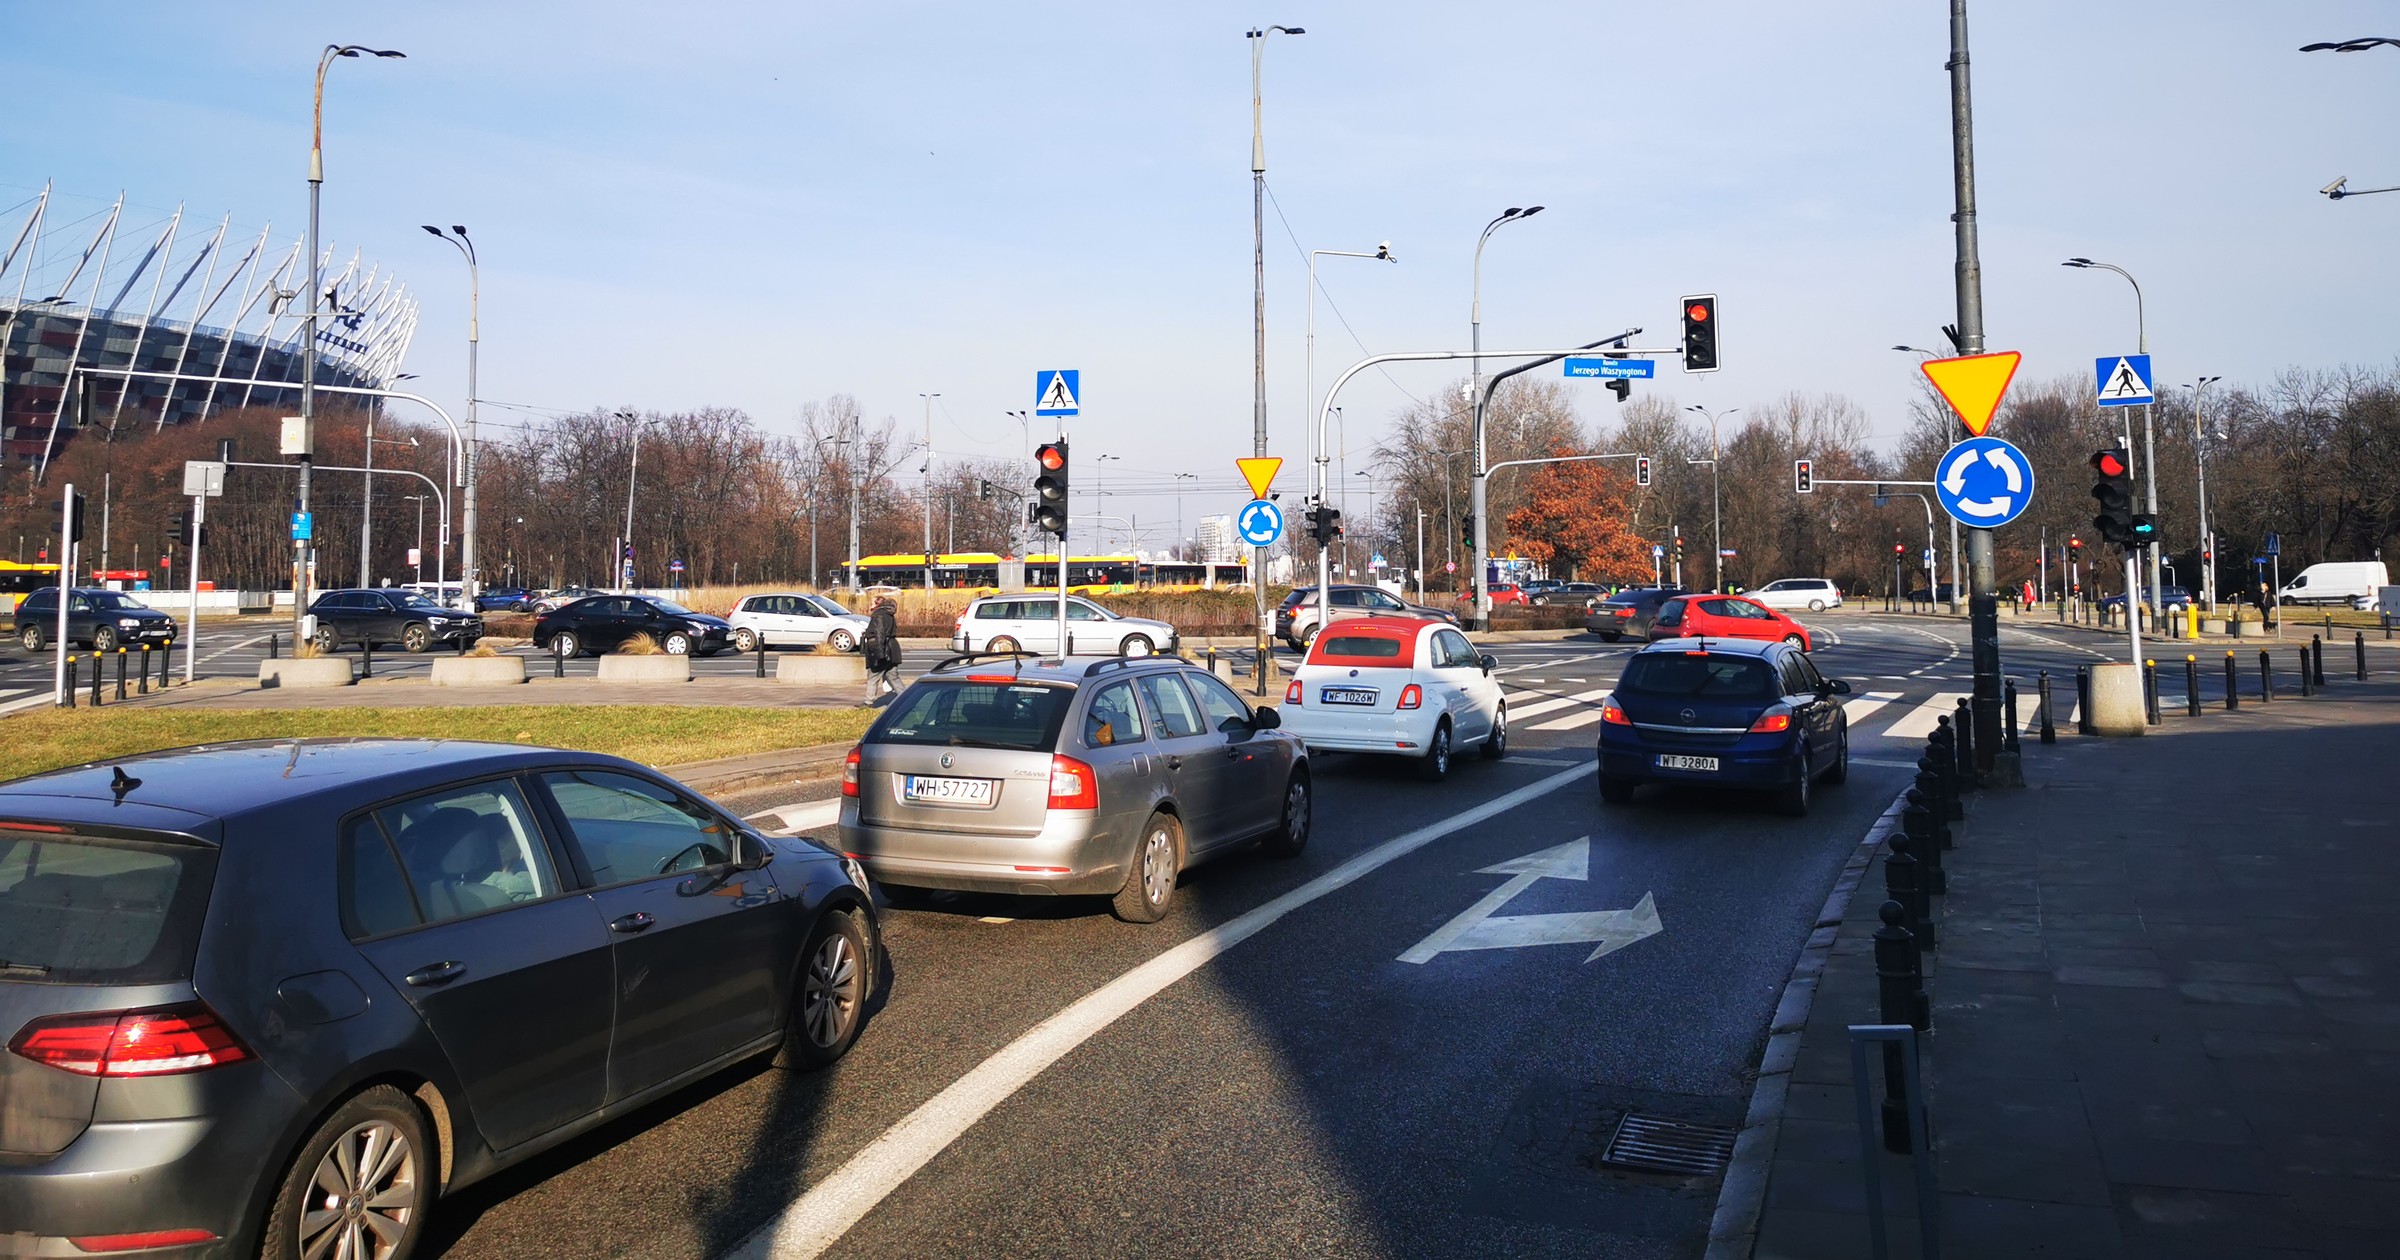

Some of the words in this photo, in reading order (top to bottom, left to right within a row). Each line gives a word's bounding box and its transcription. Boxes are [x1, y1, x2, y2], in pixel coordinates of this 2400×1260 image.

[1572, 366, 1600, 377] Jerzego
[1600, 366, 1647, 378] Waszyngtona
[1328, 692, 1341, 701] WF
[1345, 692, 1373, 703] 1026W
[1662, 755, 1677, 767] WT
[1681, 756, 1716, 770] 3280A
[916, 778, 937, 796] WH
[942, 780, 989, 798] 57727
